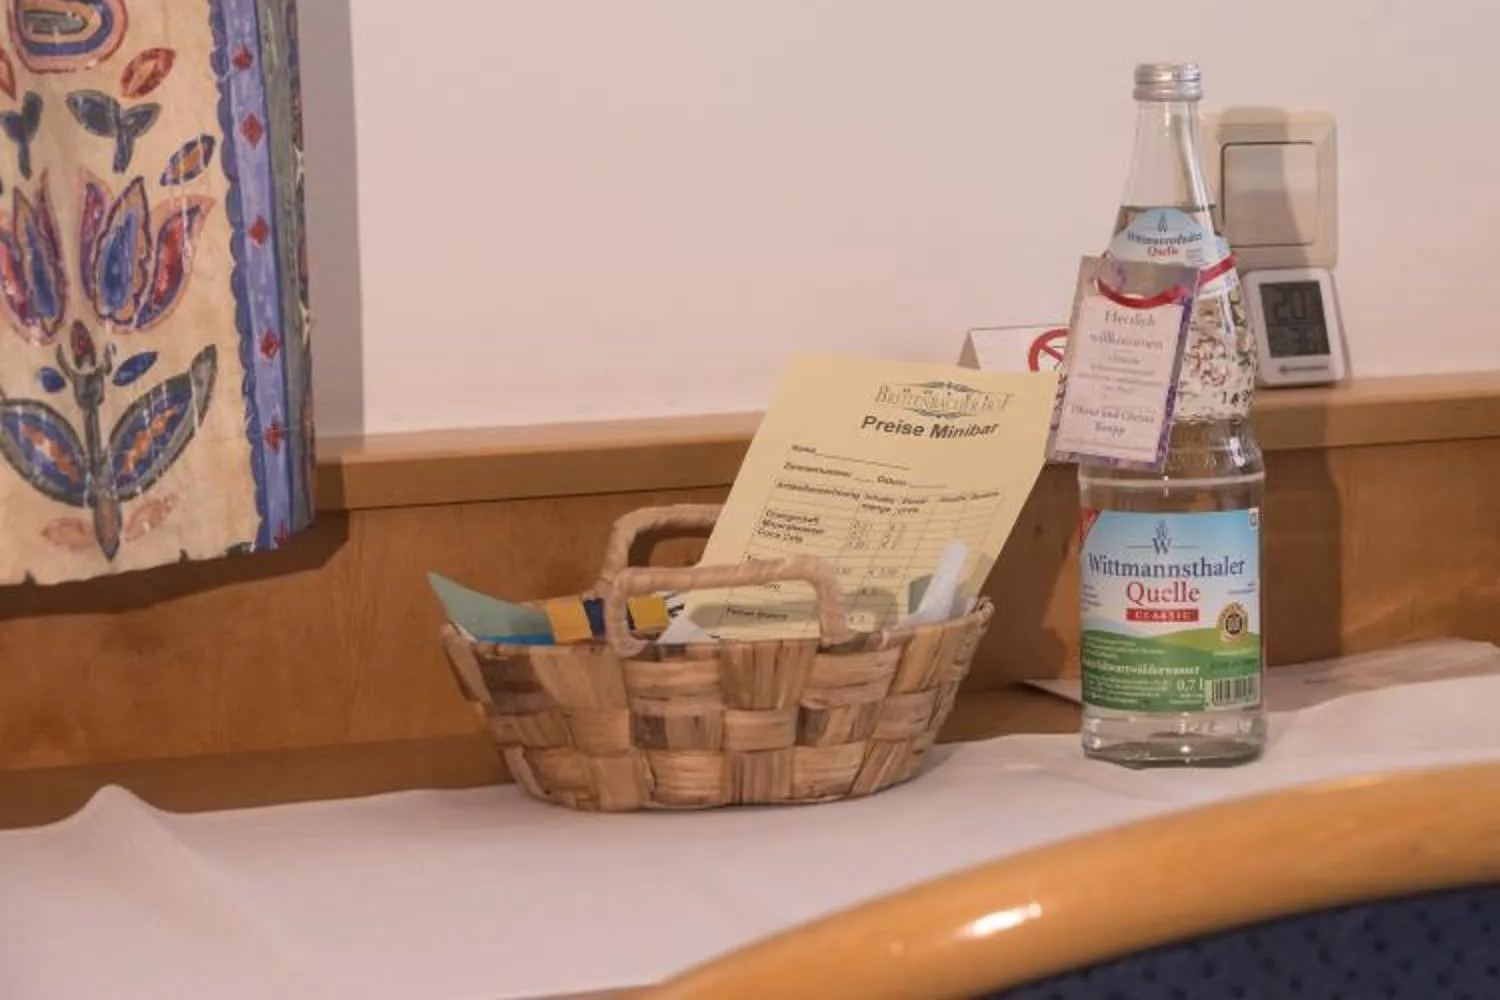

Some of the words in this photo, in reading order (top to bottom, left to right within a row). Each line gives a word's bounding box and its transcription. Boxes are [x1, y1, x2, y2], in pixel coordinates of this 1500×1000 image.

[860, 413, 925, 437] Preise
[929, 421, 1000, 439] Minibar
[1087, 551, 1246, 578] Wittmannsthaler
[1126, 580, 1201, 606] Quelle
